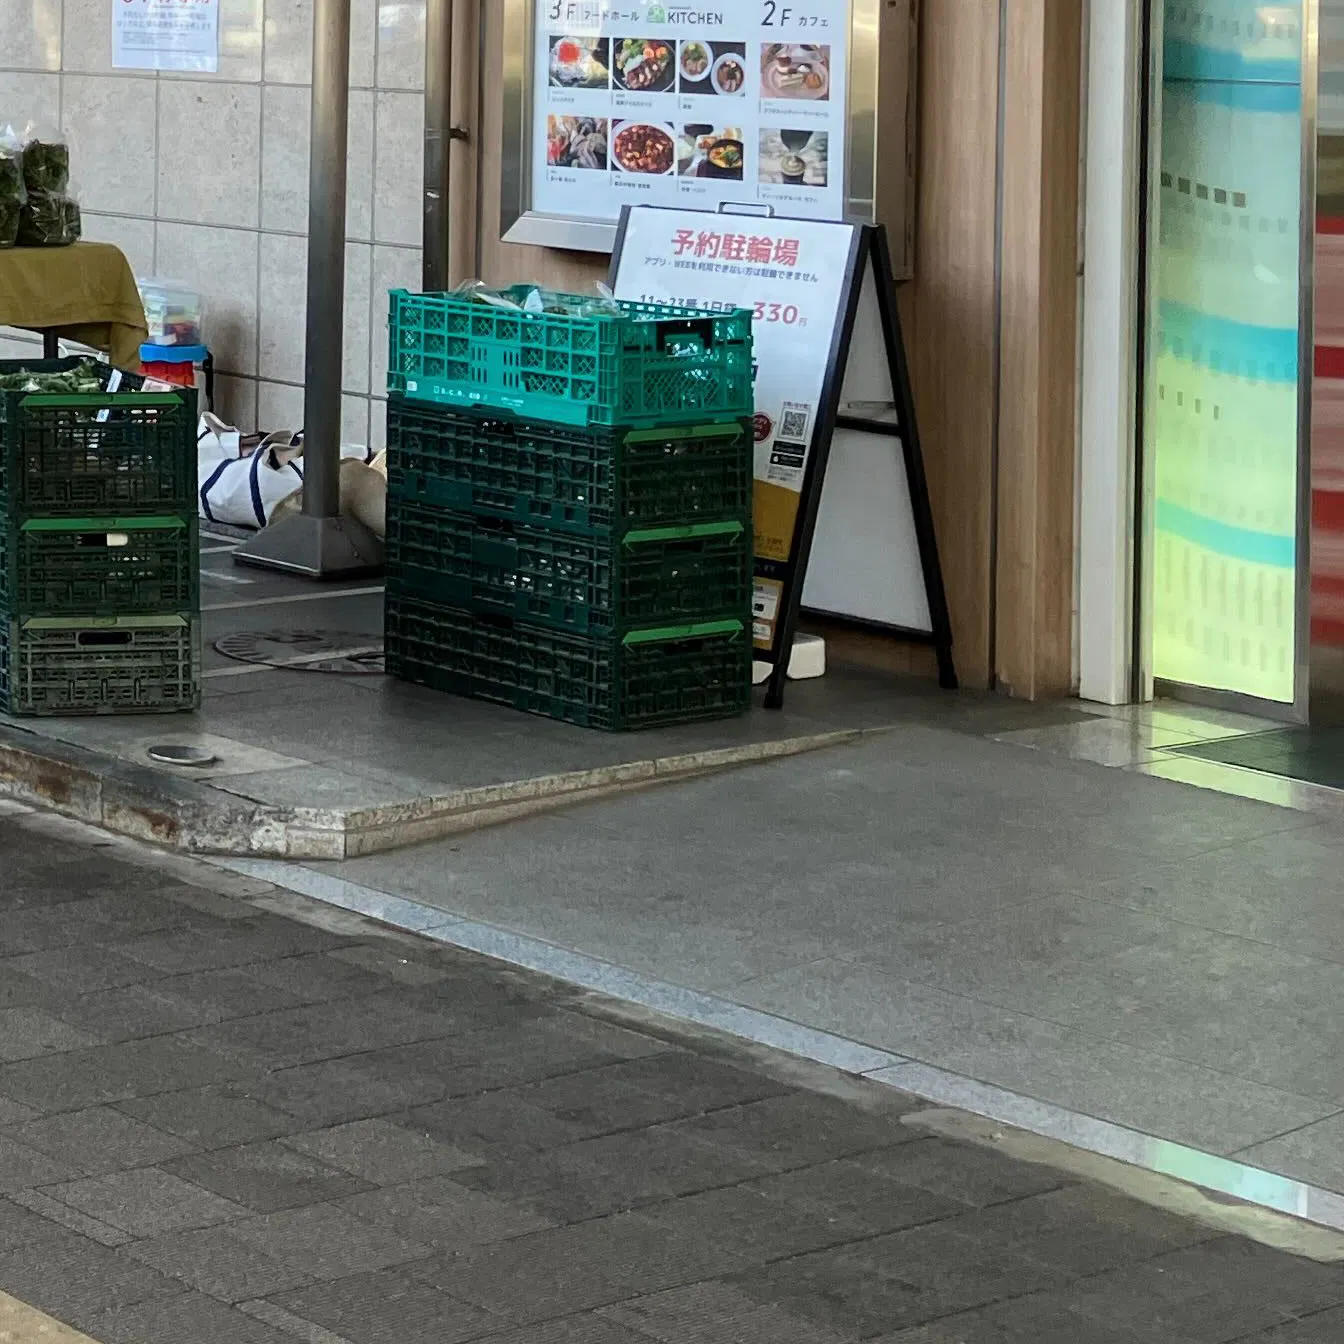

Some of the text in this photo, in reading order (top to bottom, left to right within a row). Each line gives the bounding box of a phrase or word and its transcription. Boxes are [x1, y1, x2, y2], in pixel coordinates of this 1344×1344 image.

[667, 11, 724, 25] KITCHEN
[798, 16, 830, 27] カフェ
[670, 229, 800, 267] 予約駐輪場
